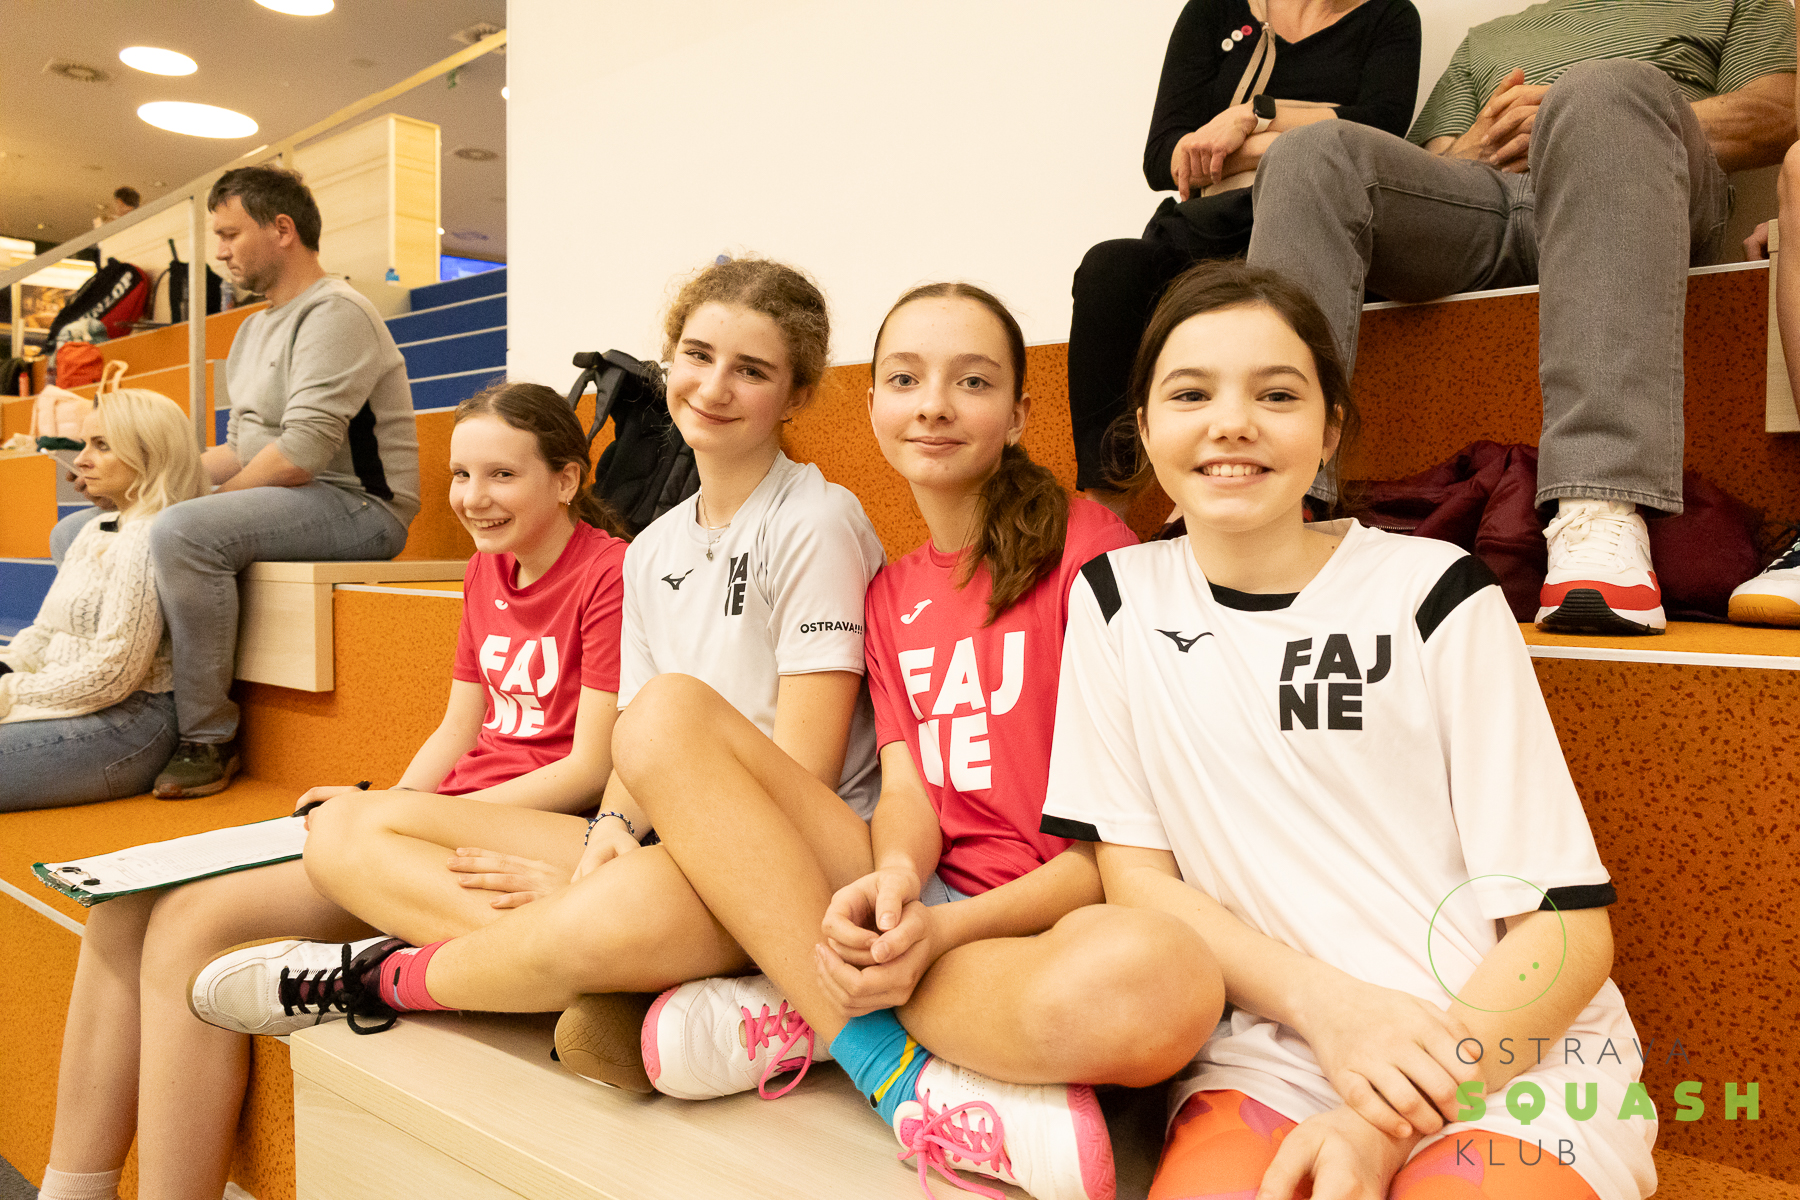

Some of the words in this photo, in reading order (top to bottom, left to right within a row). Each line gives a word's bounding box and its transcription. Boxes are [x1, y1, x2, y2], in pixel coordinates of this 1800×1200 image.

[800, 620, 863, 635] OSTRAVA!!!
[479, 634, 560, 698] FAJ
[898, 630, 1026, 721] FAJ
[1279, 633, 1392, 684] FAJ
[1279, 682, 1363, 731] NE
